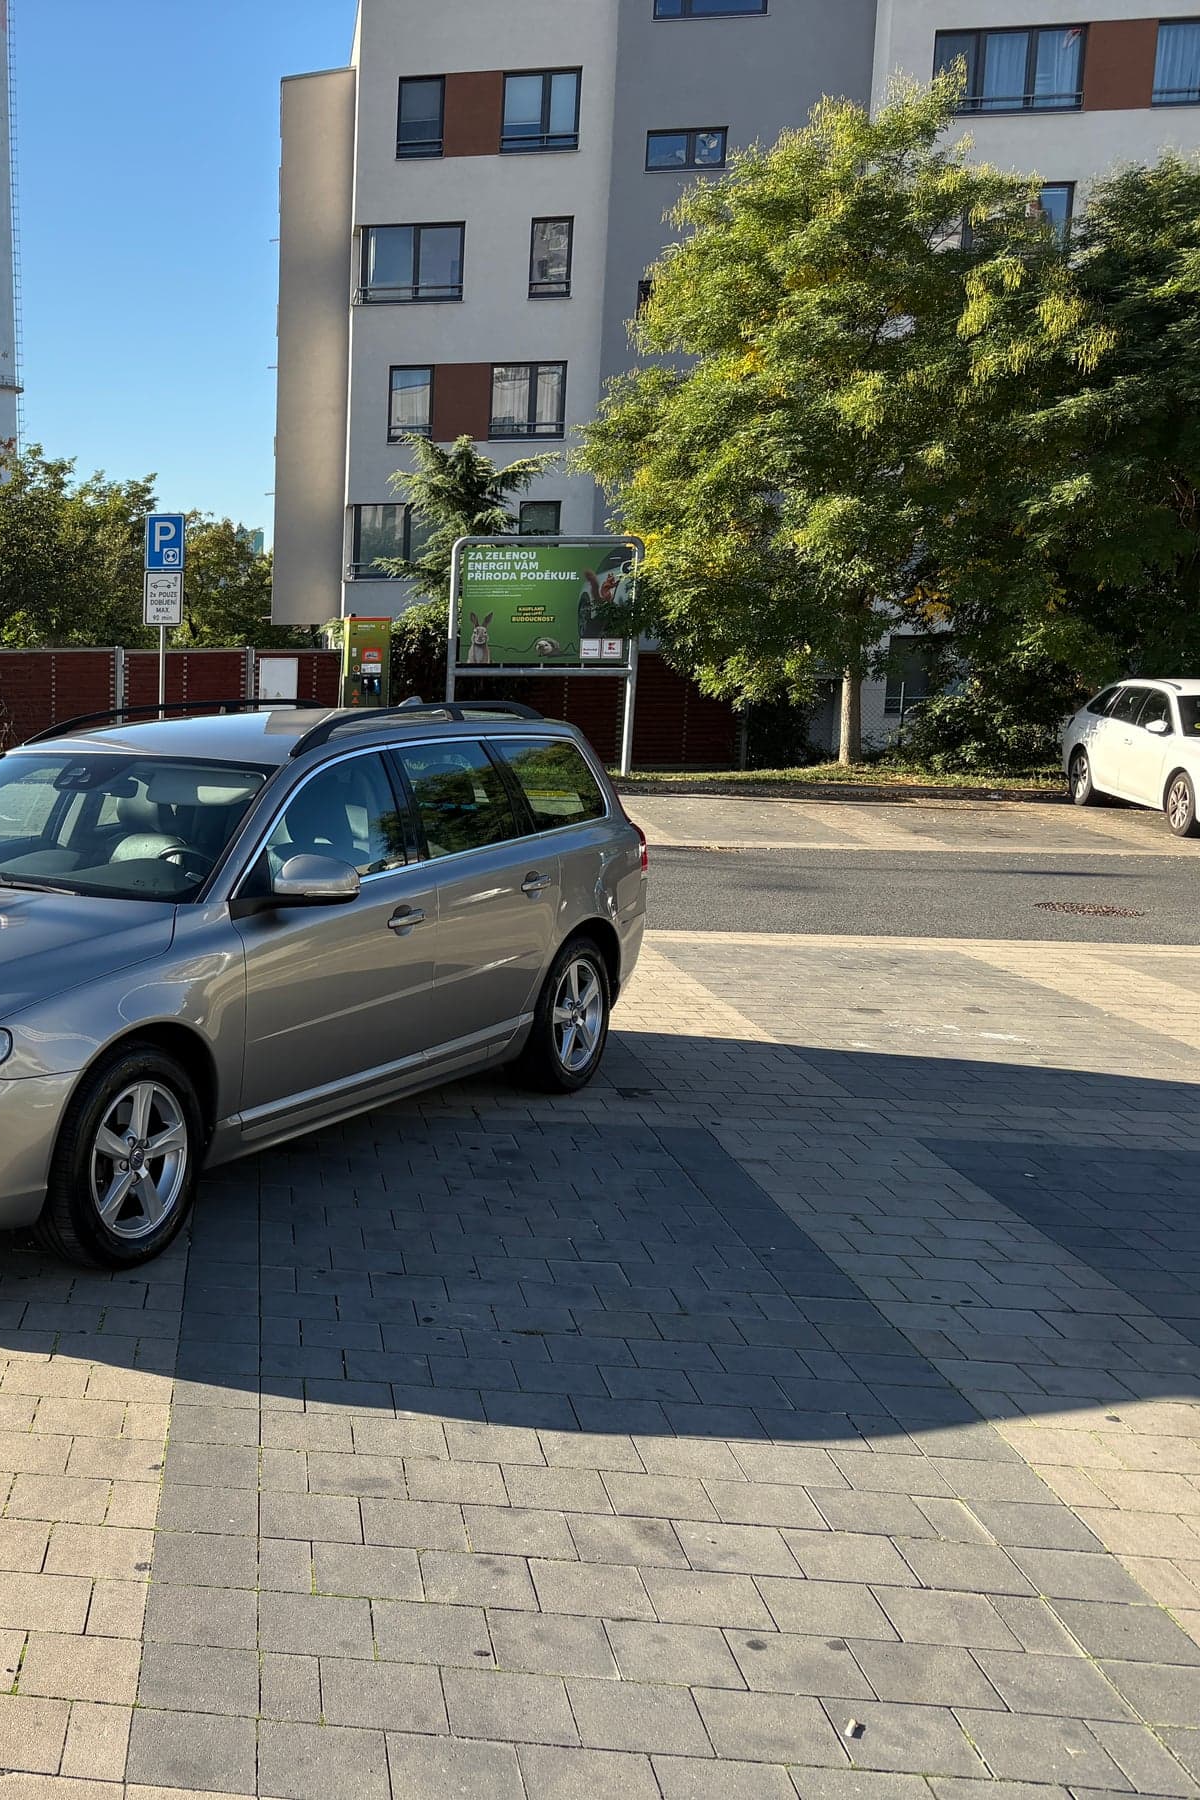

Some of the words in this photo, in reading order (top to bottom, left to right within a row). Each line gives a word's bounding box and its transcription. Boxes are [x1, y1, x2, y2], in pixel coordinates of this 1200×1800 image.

[154, 522, 176, 553] P
[467, 551, 483, 560] ZA
[485, 551, 537, 560] ZELENOU
[467, 561, 511, 571] ENERGII
[514, 560, 539, 571] VÁM
[467, 570, 517, 581] PŘÍRODA
[520, 569, 580, 580] PODĚKUJE.
